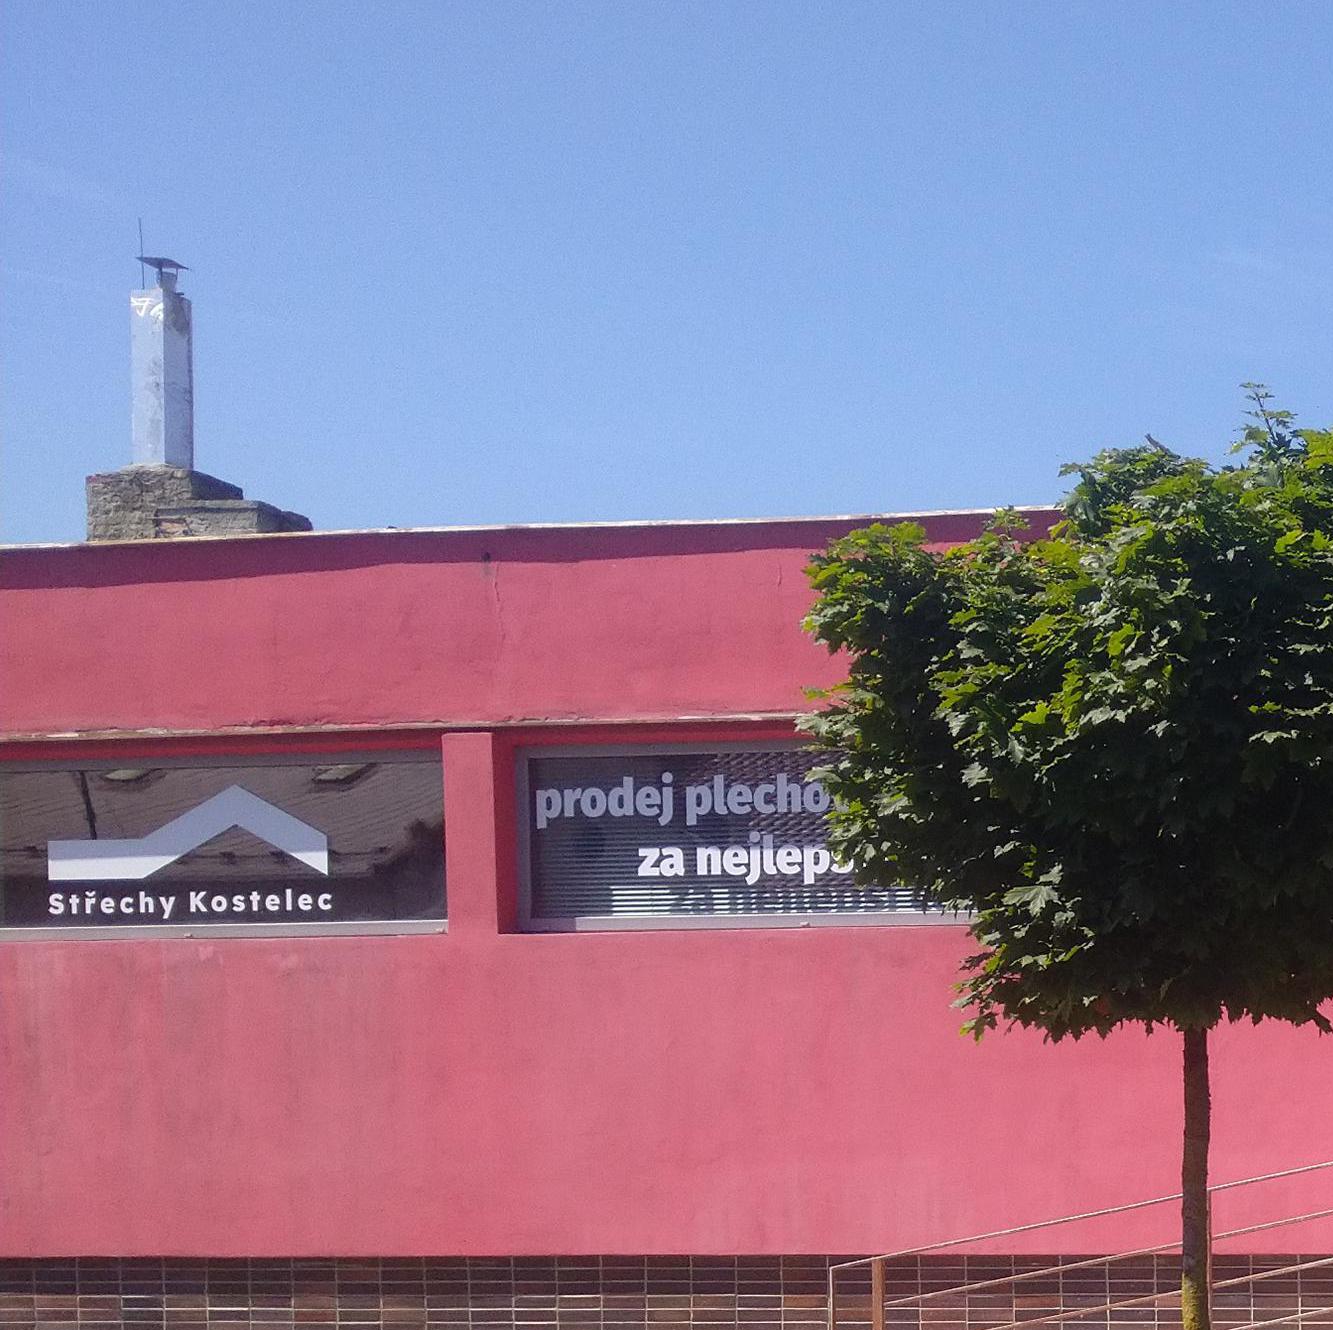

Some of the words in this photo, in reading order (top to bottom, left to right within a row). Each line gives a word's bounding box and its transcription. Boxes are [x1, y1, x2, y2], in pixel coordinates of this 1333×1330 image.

[536, 771, 673, 829] prodej
[686, 773, 831, 826] plecho
[638, 844, 685, 877] za
[48, 891, 175, 918] Střechy
[190, 889, 332, 914] Kostelec
